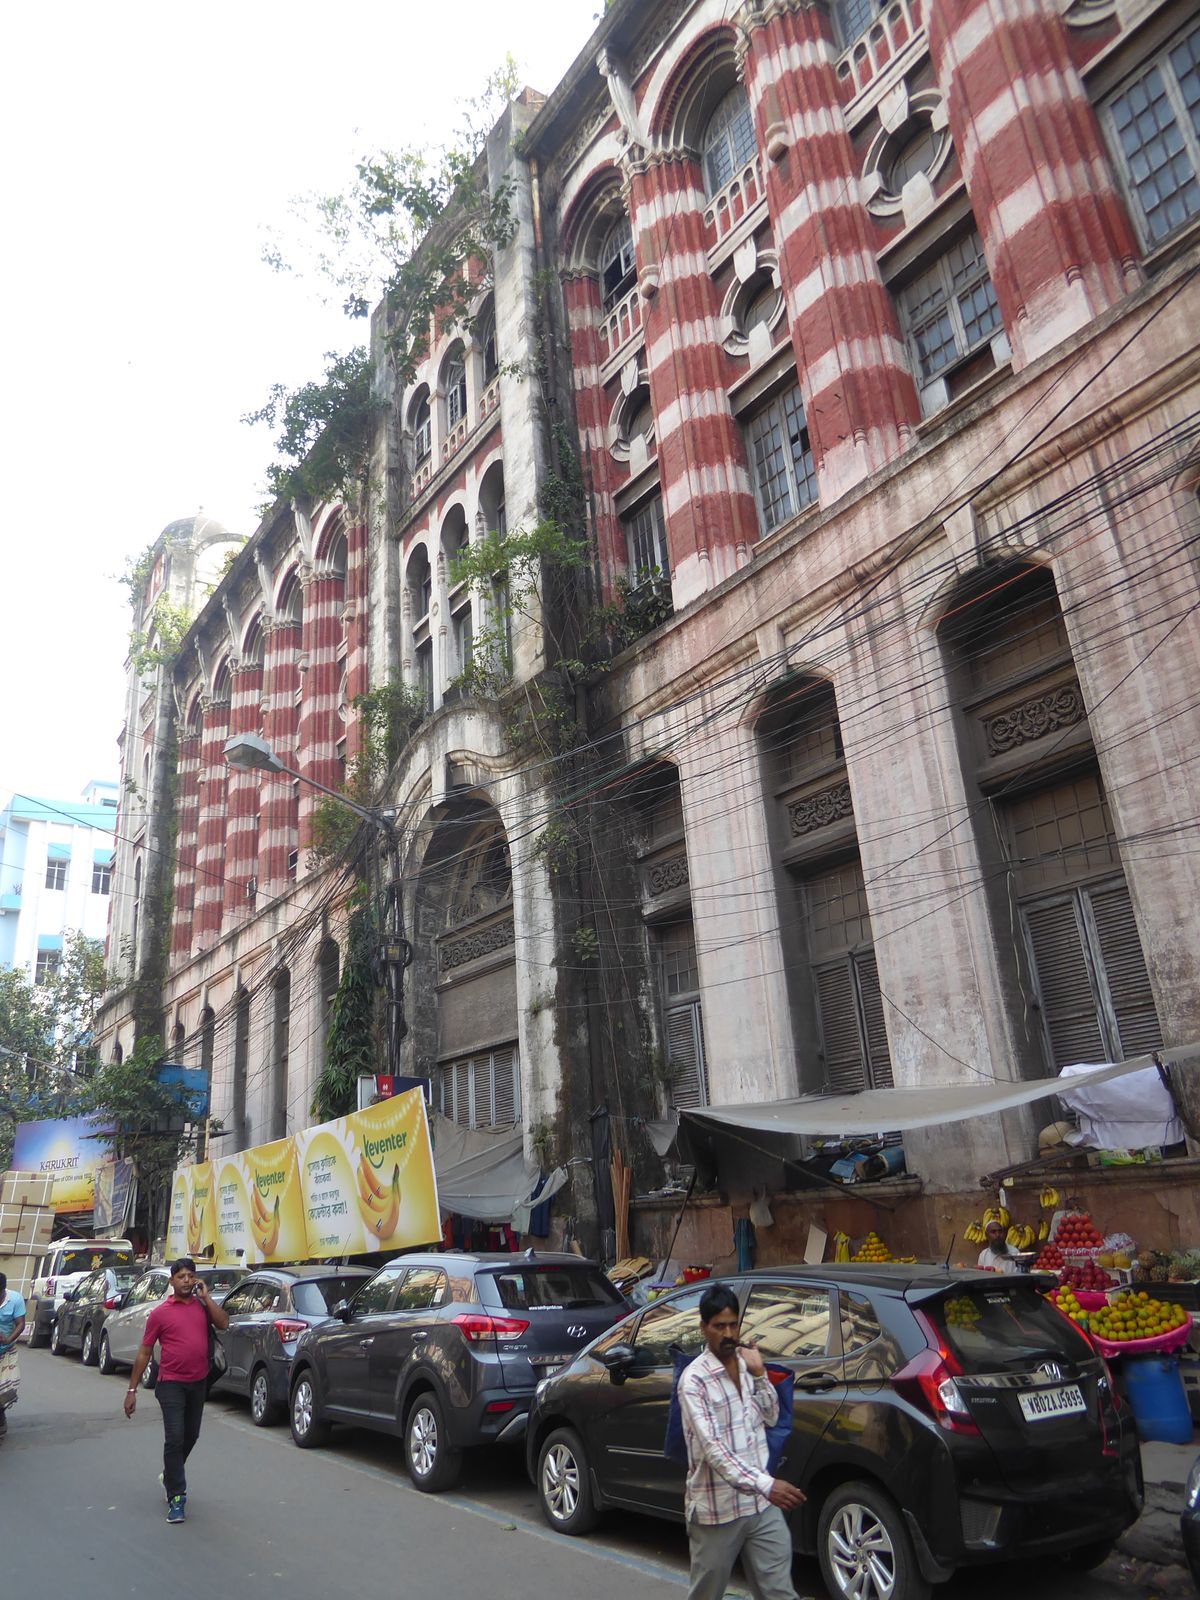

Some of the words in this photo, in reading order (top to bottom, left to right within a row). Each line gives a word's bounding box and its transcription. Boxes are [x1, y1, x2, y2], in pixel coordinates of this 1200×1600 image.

[363, 1132, 407, 1157] keventer
[40, 1157, 79, 1171] KARUKRIT
[255, 1168, 286, 1188] keventer
[1026, 1390, 1083, 1415] WB02AJ5895
